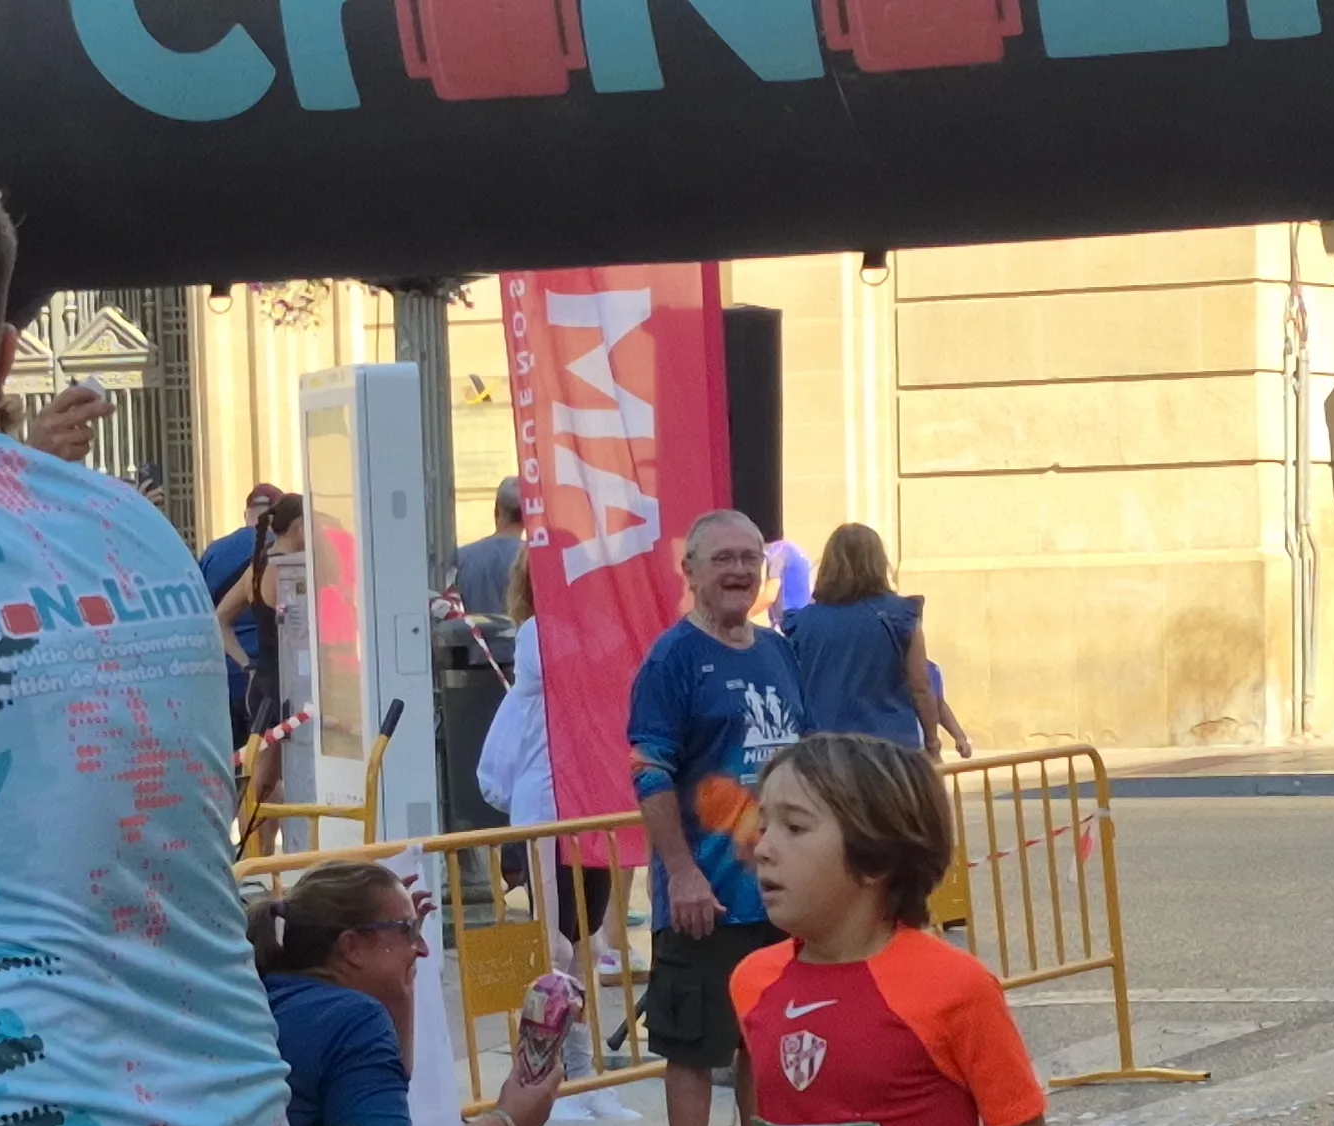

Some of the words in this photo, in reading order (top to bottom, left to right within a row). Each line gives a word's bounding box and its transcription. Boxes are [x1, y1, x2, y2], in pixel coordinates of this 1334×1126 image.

[73, 643, 96, 662] de
[69, 668, 94, 688] de
[97, 664, 165, 686] eventos
